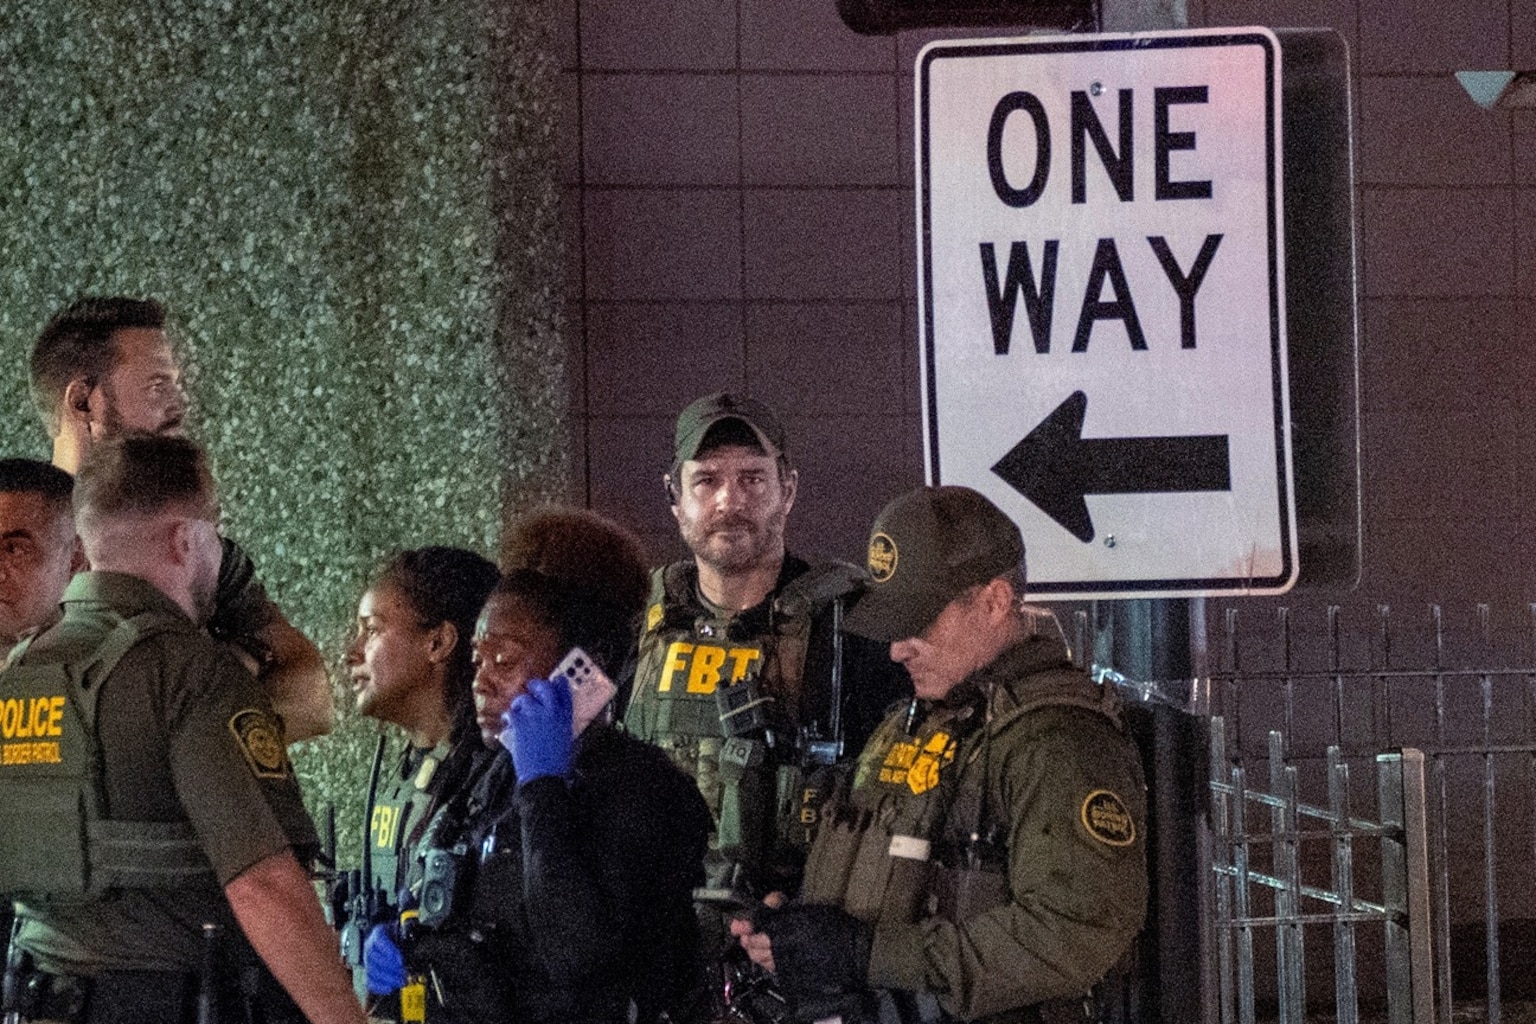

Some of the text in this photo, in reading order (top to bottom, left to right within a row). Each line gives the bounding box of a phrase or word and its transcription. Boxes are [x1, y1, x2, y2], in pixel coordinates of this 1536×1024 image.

[986, 85, 1213, 208] ONE
[979, 233, 1224, 355] WAY
[371, 805, 399, 849] FBI
